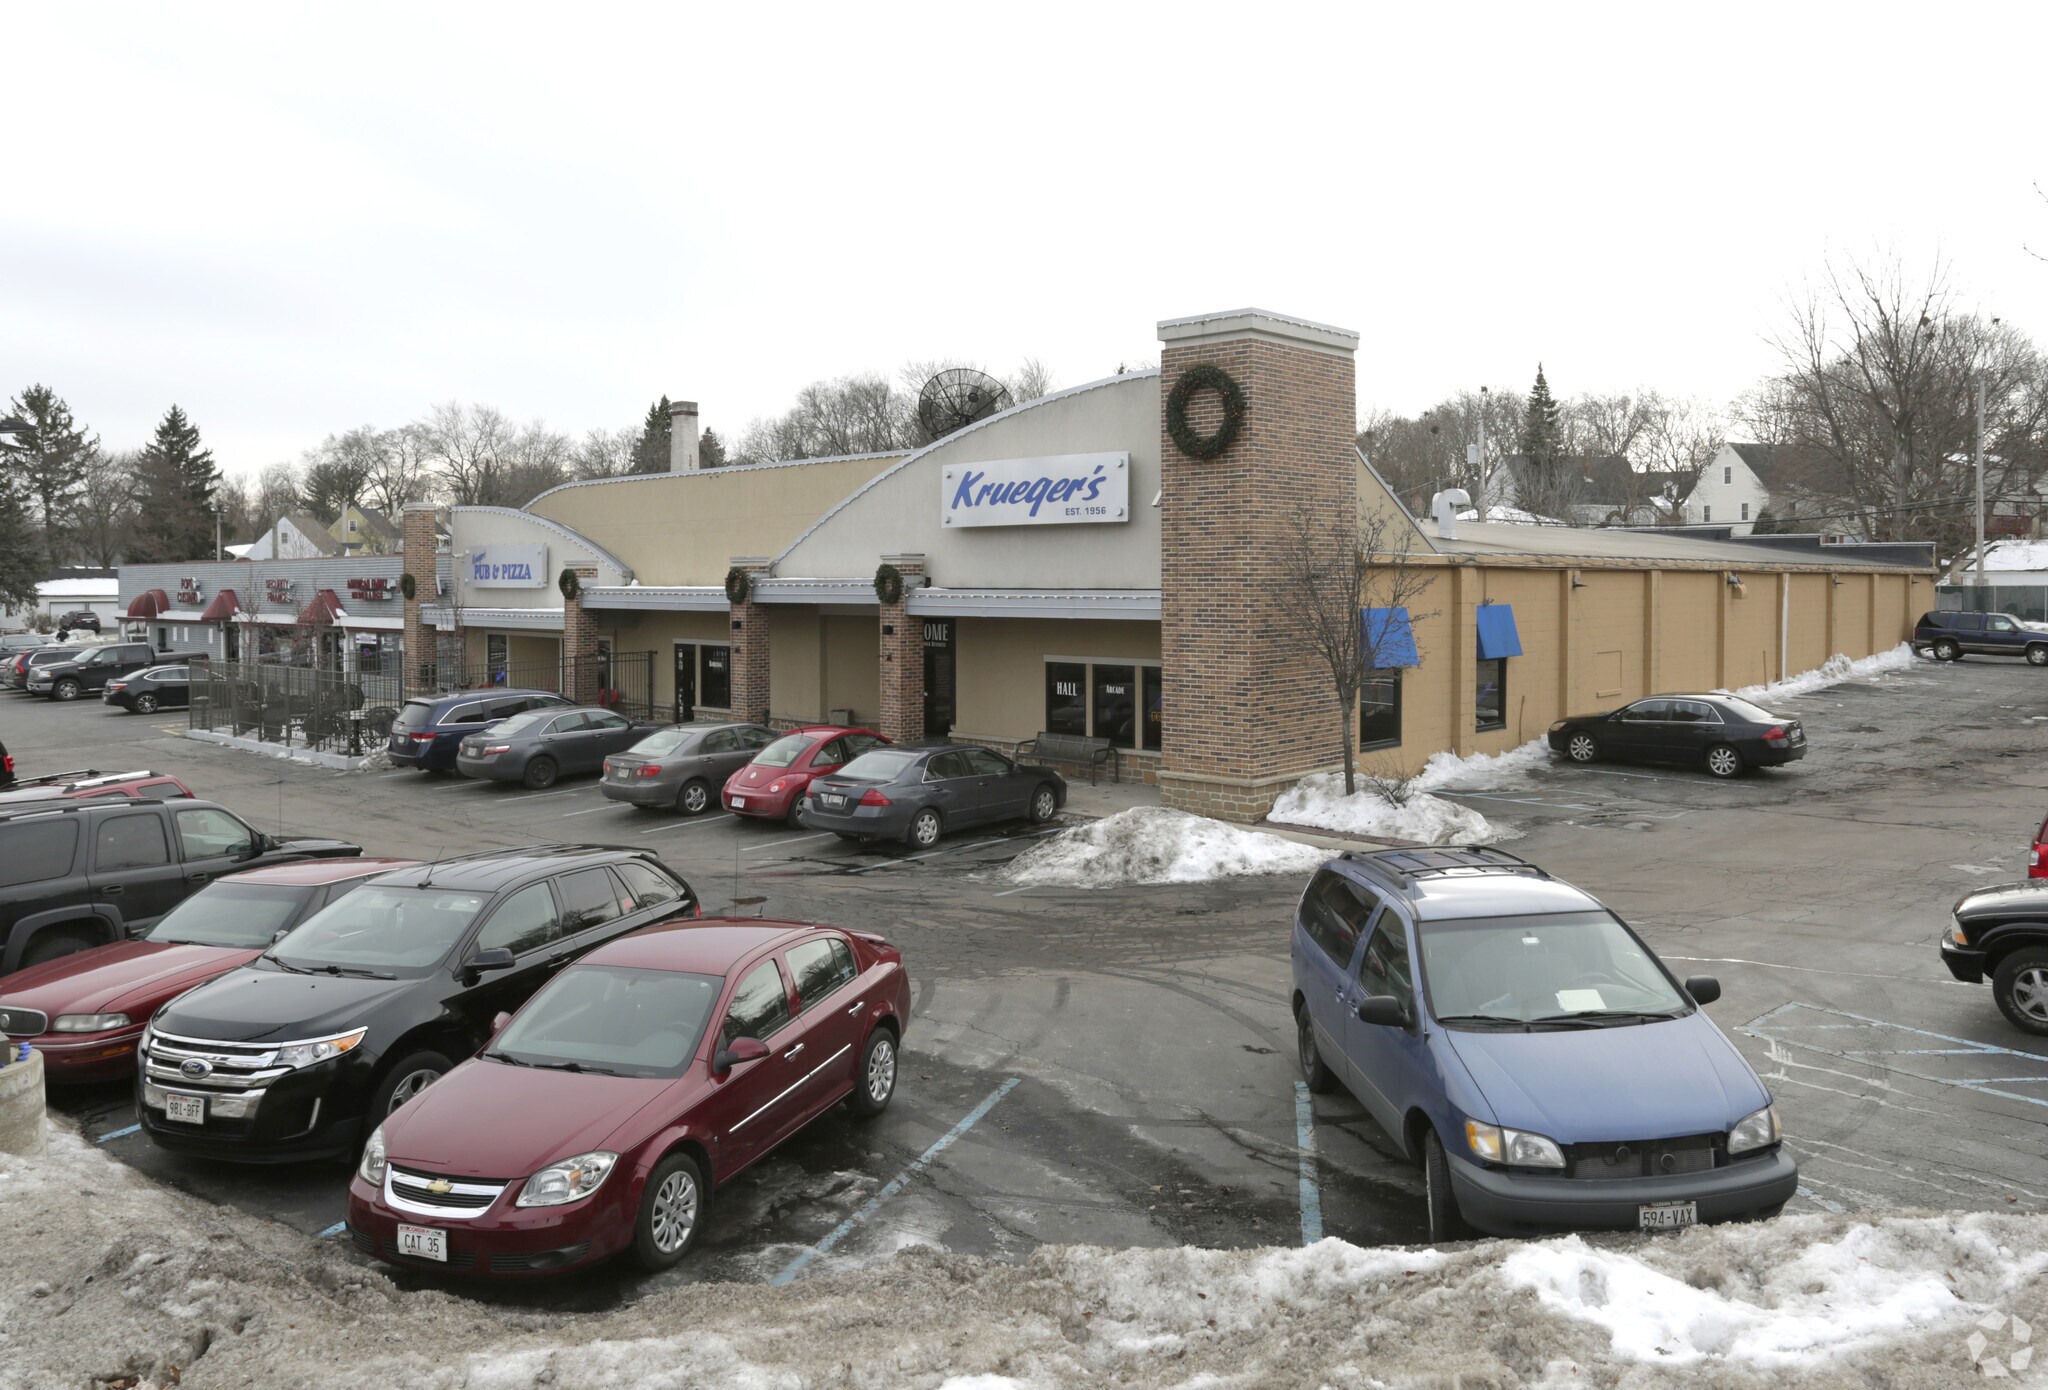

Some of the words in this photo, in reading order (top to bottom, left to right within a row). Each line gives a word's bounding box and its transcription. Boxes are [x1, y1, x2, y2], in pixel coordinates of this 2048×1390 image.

[951, 465, 1107, 517] Krueger's
[1065, 508, 1082, 516] EST.
[1084, 506, 1107, 515] 1956
[474, 564, 491, 580] PUB
[492, 564, 500, 580] &
[501, 564, 532, 580] PIZZA
[1056, 682, 1077, 697] HALL
[169, 1102, 201, 1118] 981-BFF
[1643, 1207, 1693, 1227] 594-VAX
[404, 1233, 422, 1250] CAT
[427, 1236, 440, 1253] 35
